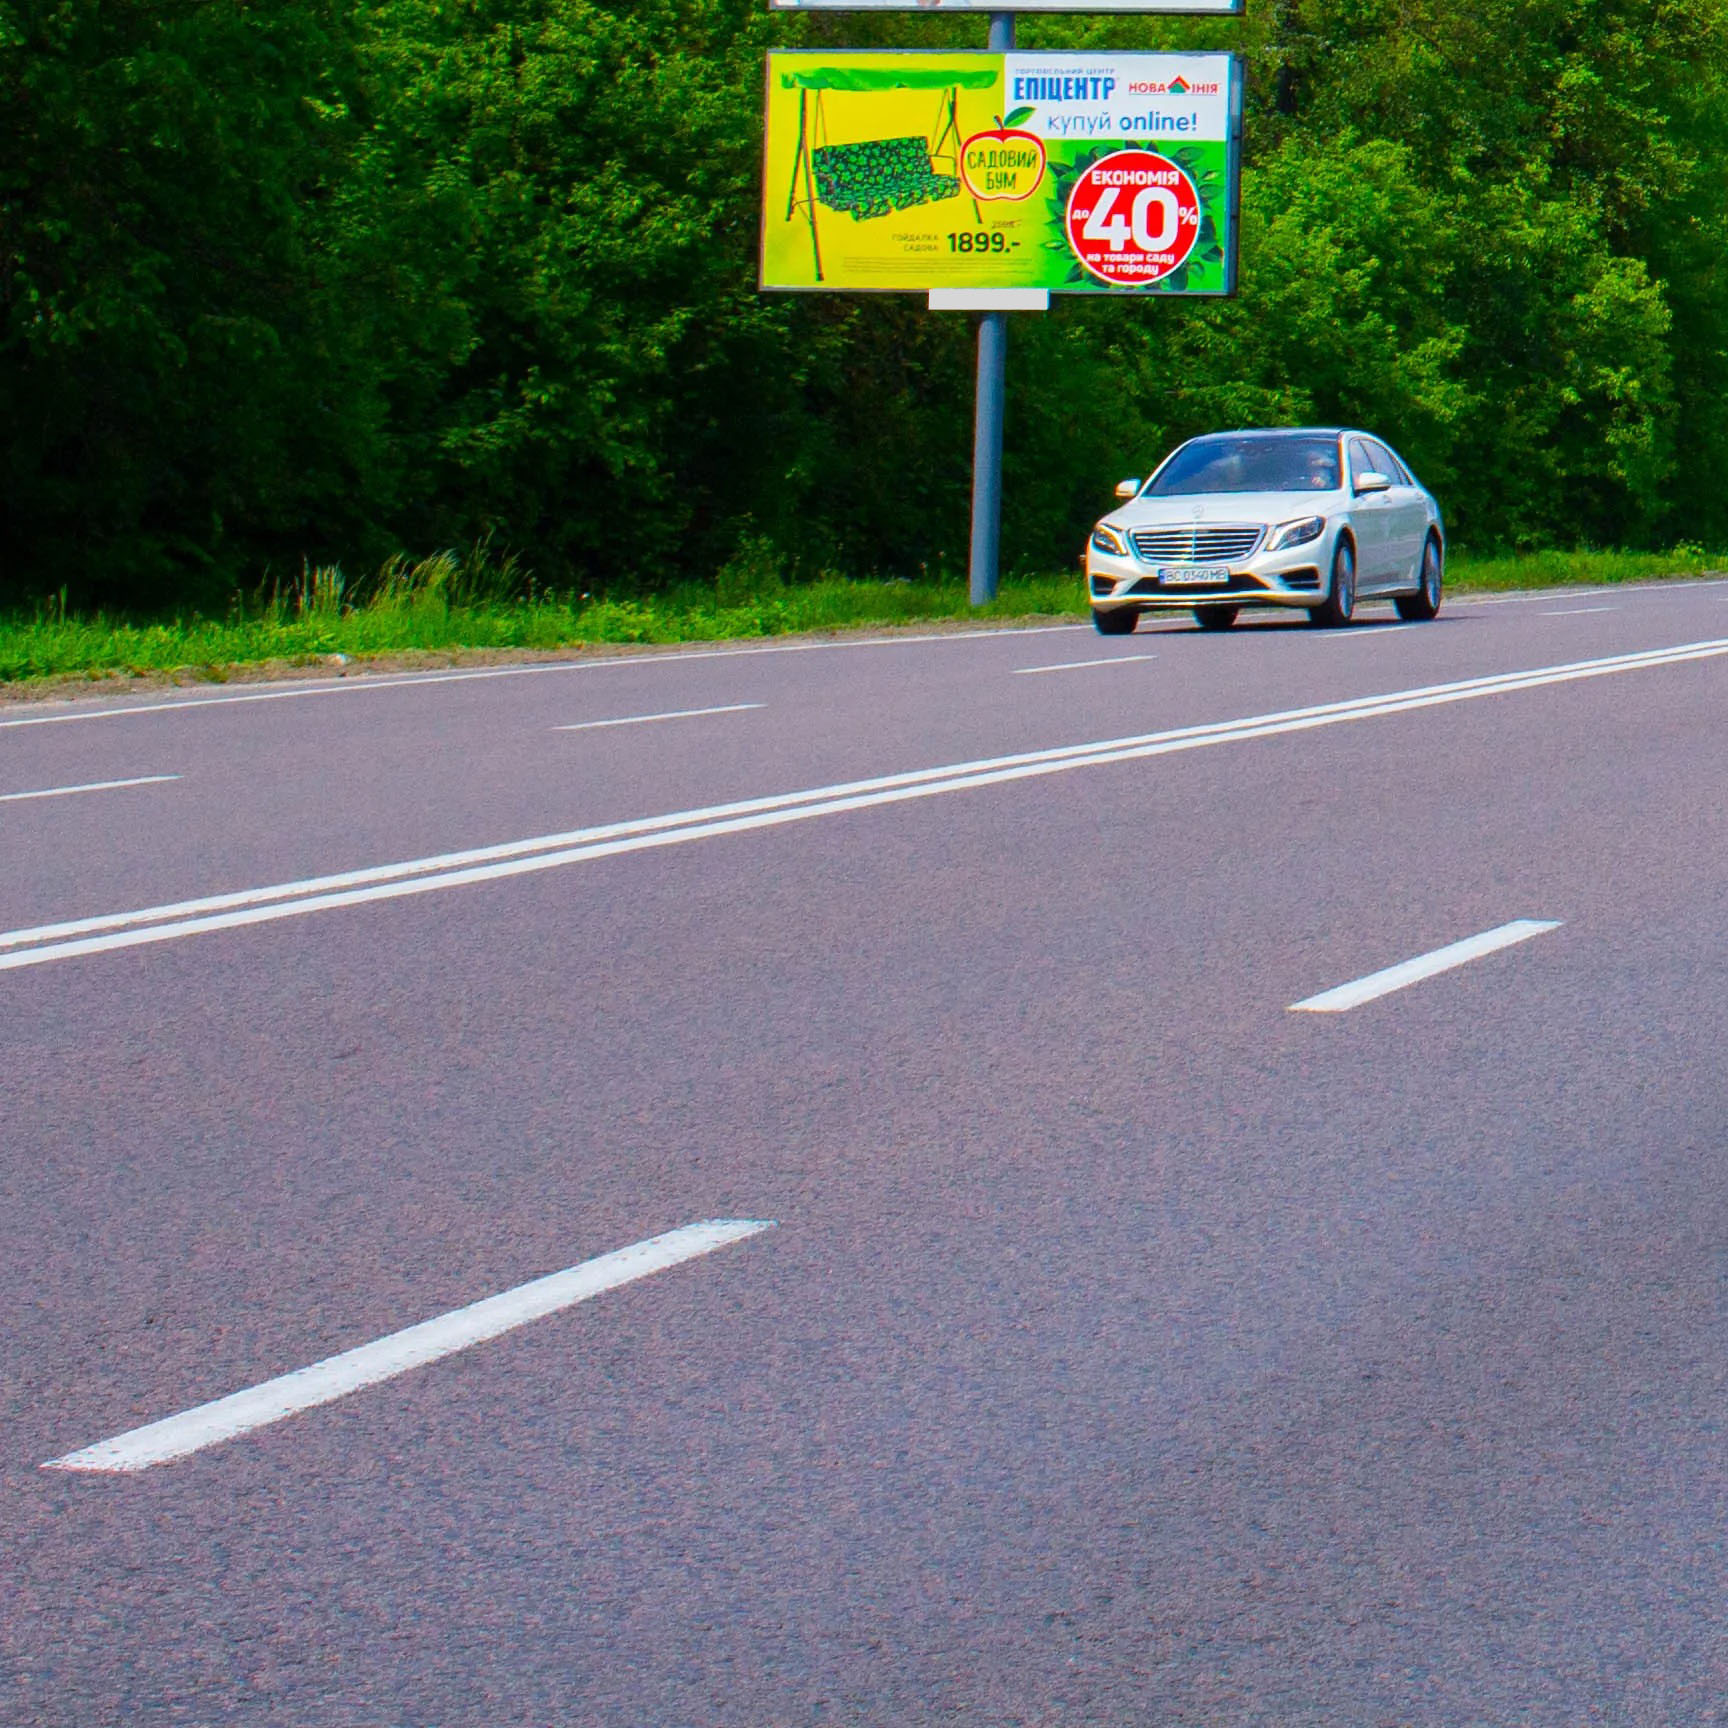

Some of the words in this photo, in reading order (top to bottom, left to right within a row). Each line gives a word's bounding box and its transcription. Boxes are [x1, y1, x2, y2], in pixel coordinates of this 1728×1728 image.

[1014, 76, 1116, 101] ЕПІЦЕНТР
[1048, 111, 1112, 135] купуй
[1119, 110, 1197, 131] online!
[967, 149, 1037, 169] САДОВИЙ
[986, 171, 1017, 190] БУМ
[1091, 170, 1179, 186] ЕКОНОМІЯ
[1104, 254, 1144, 265] товари
[1146, 254, 1175, 265] саду
[1118, 265, 1159, 276] городу
